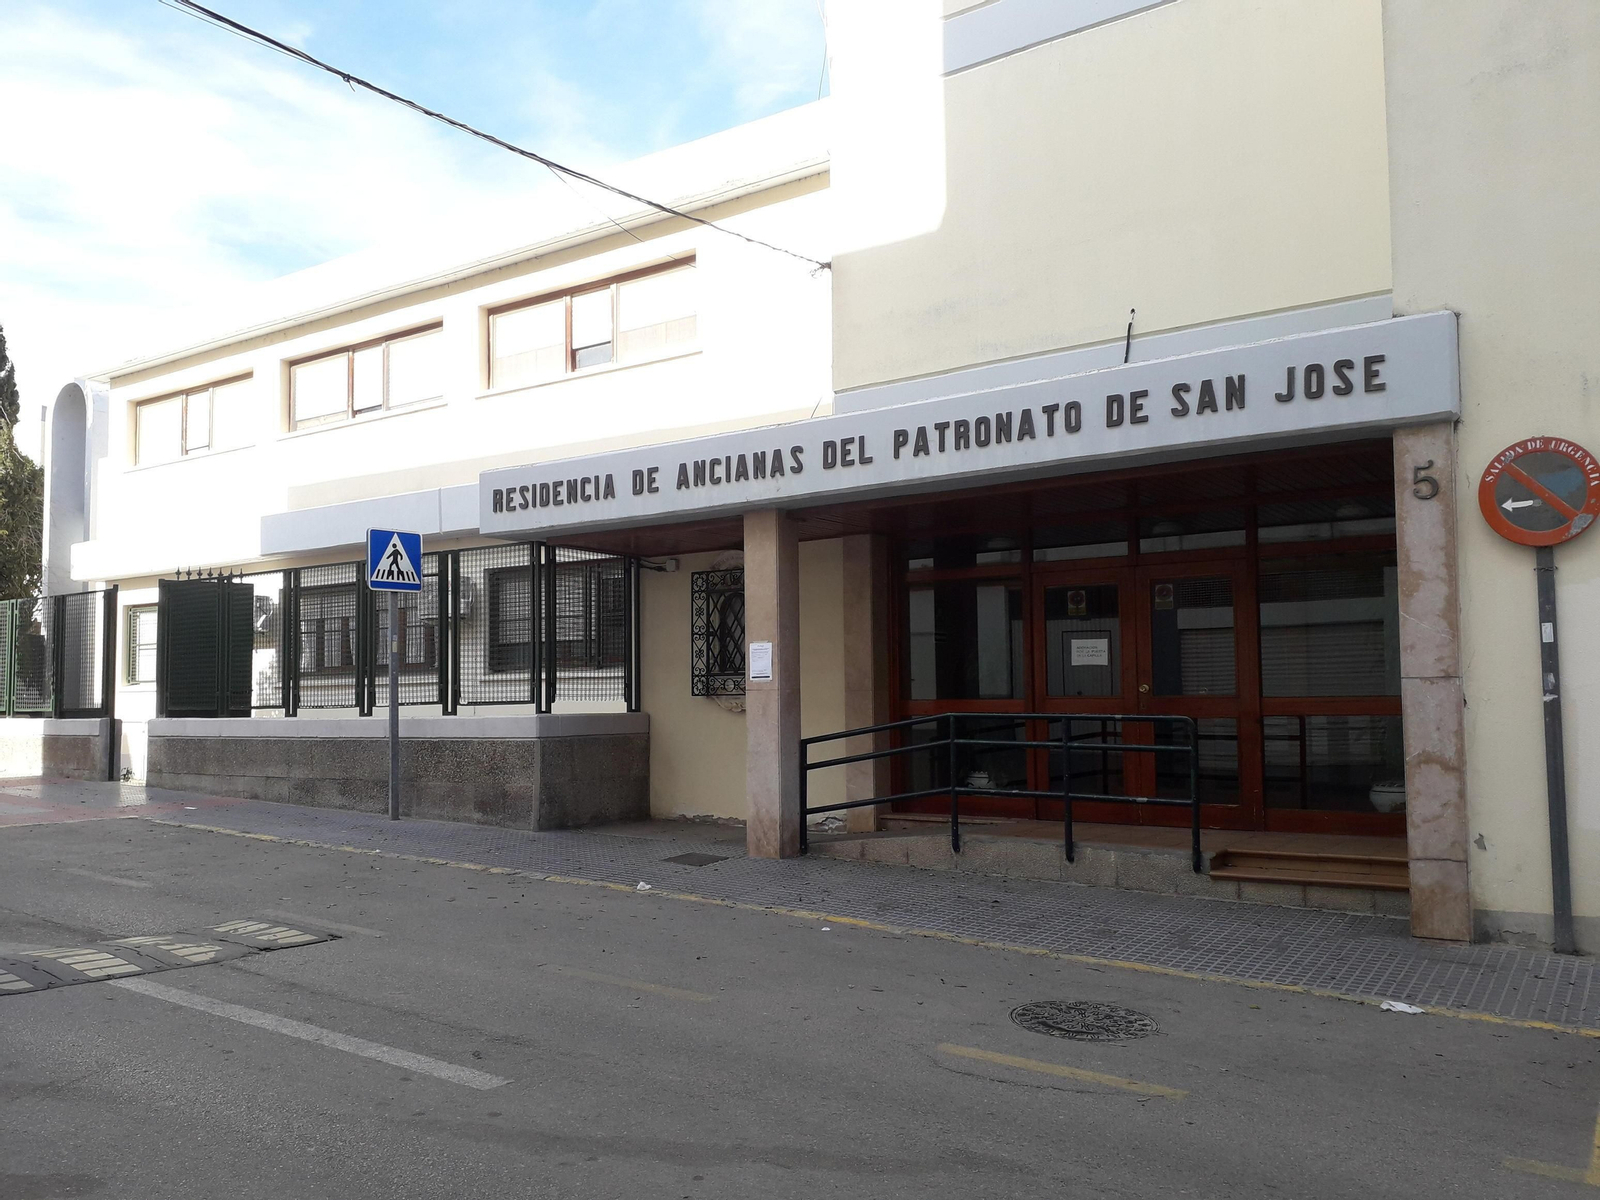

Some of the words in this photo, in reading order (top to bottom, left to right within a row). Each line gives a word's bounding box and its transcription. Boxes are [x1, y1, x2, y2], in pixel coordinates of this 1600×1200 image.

[492, 473, 616, 513] RESIDENCIA
[631, 466, 660, 496] DE
[676, 445, 804, 490] ANCIANAS
[822, 435, 873, 470] DEL
[893, 400, 1082, 459] PATRONATO
[1106, 389, 1149, 428] DE
[1170, 373, 1246, 417] SAN
[1274, 354, 1387, 403] JOSE
[1412, 459, 1440, 500] 5
[1484, 446, 1524, 483] SALIDA
[1526, 439, 1545, 450] DE
[1550, 440, 1600, 487] URGENCIA
